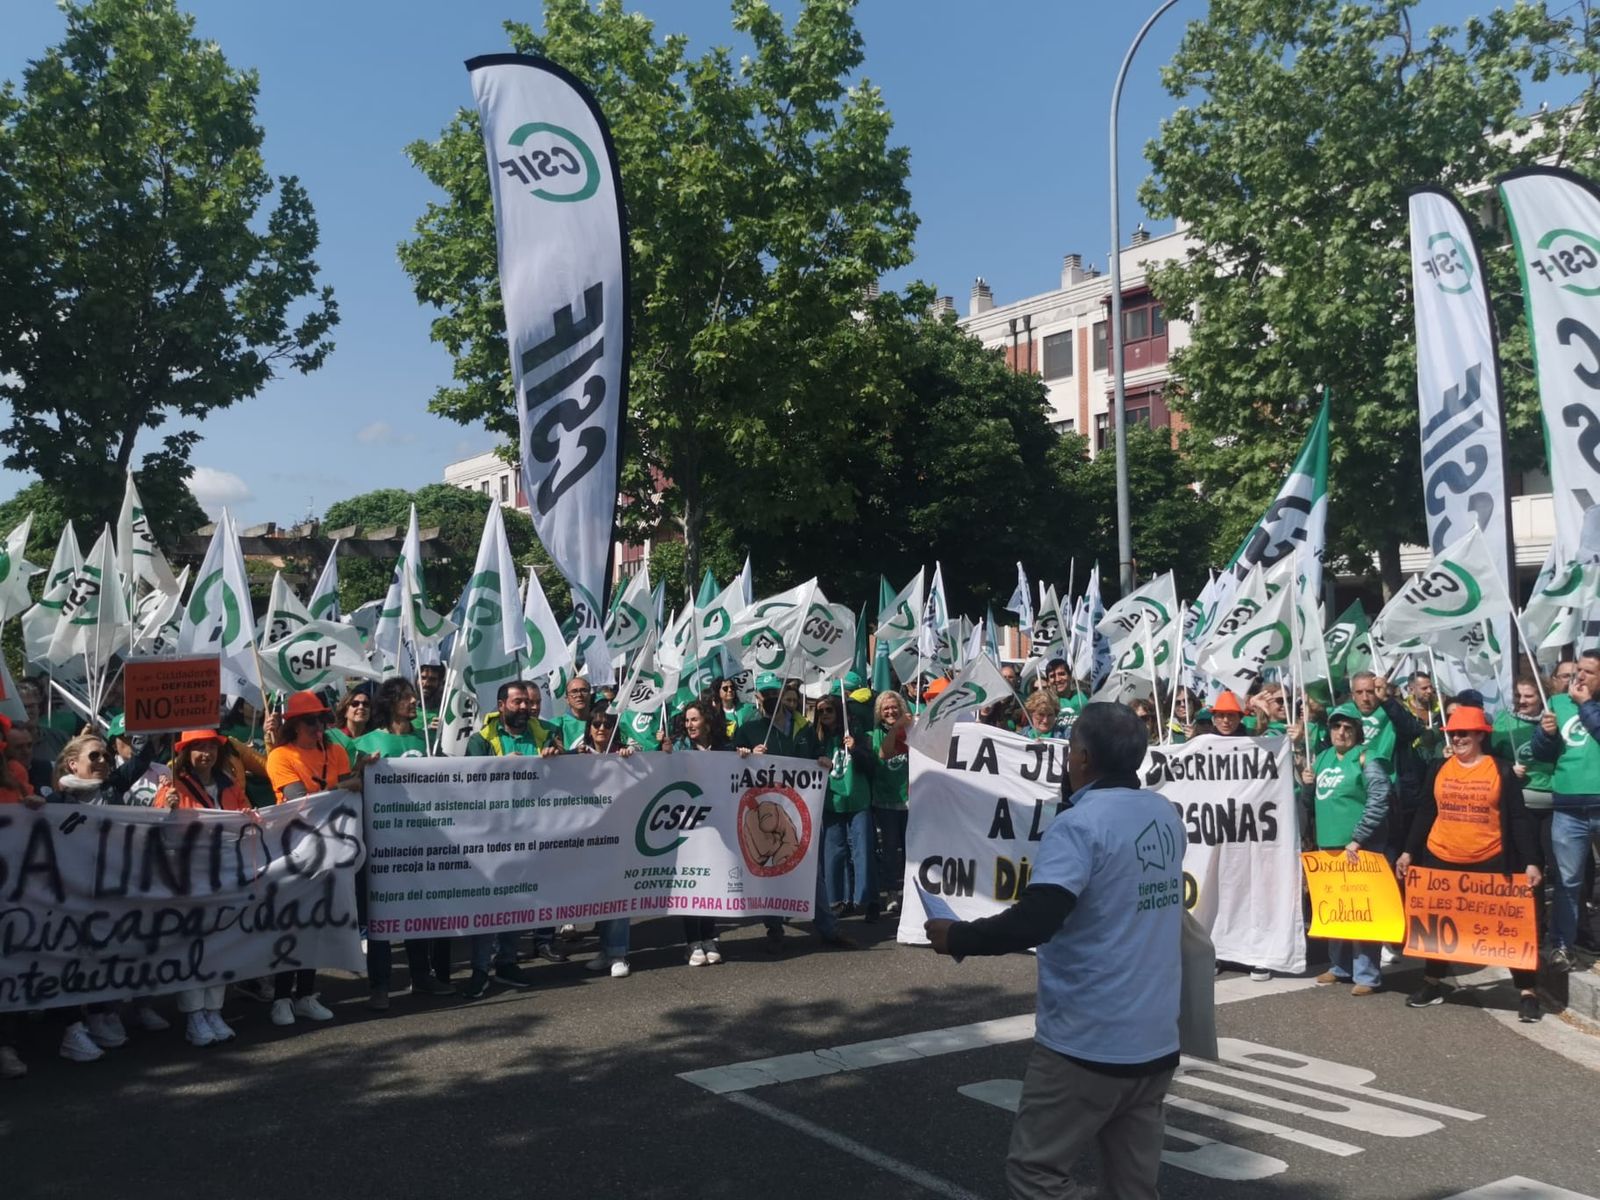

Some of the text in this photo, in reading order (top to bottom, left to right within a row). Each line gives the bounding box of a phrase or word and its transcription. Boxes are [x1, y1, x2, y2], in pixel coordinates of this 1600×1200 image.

[803, 616, 843, 645] CSIF
[289, 644, 338, 676] CSIF
[134, 697, 171, 721] NO
[947, 736, 999, 775] LA
[374, 772, 450, 785] Reclasificación
[466, 774, 487, 785] pero
[489, 773, 510, 784] para
[511, 771, 540, 782] todos.
[373, 794, 613, 814] Continuidad asistencial para todos los profesionales
[372, 817, 456, 831] que la requieran.
[649, 804, 712, 831] CSIF
[987, 798, 1016, 840] A
[371, 834, 620, 859] Jubilación parcial para todos en el porcentaje máximo
[370, 859, 472, 875] que recoja la norma.
[624, 866, 711, 878] NO FIRMA ESTE
[918, 855, 976, 897] CON
[634, 879, 697, 890] CONVENIO
[1138, 877, 1178, 896] tienes la
[1407, 869, 1421, 889] A
[370, 890, 406, 905] Mejora
[407, 887, 423, 900] del
[425, 885, 491, 901] complemento
[1136, 893, 1179, 912] palabra
[1410, 896, 1424, 909] SE
[1428, 896, 1453, 910] LES
[369, 919, 401, 934] ESTE
[404, 915, 469, 932] CONVENIO
[473, 909, 535, 928] COLECTIVO
[538, 908, 553, 921] ES
[556, 899, 629, 919] INSUFICIENTE
[630, 899, 638, 910] E
[639, 896, 688, 910] INJUSTO
[691, 896, 723, 910] PARA
[726, 897, 746, 911] LOS
[1318, 897, 1373, 926] Calidad
[1407, 913, 1459, 954] NO
[1497, 920, 1519, 937] les
